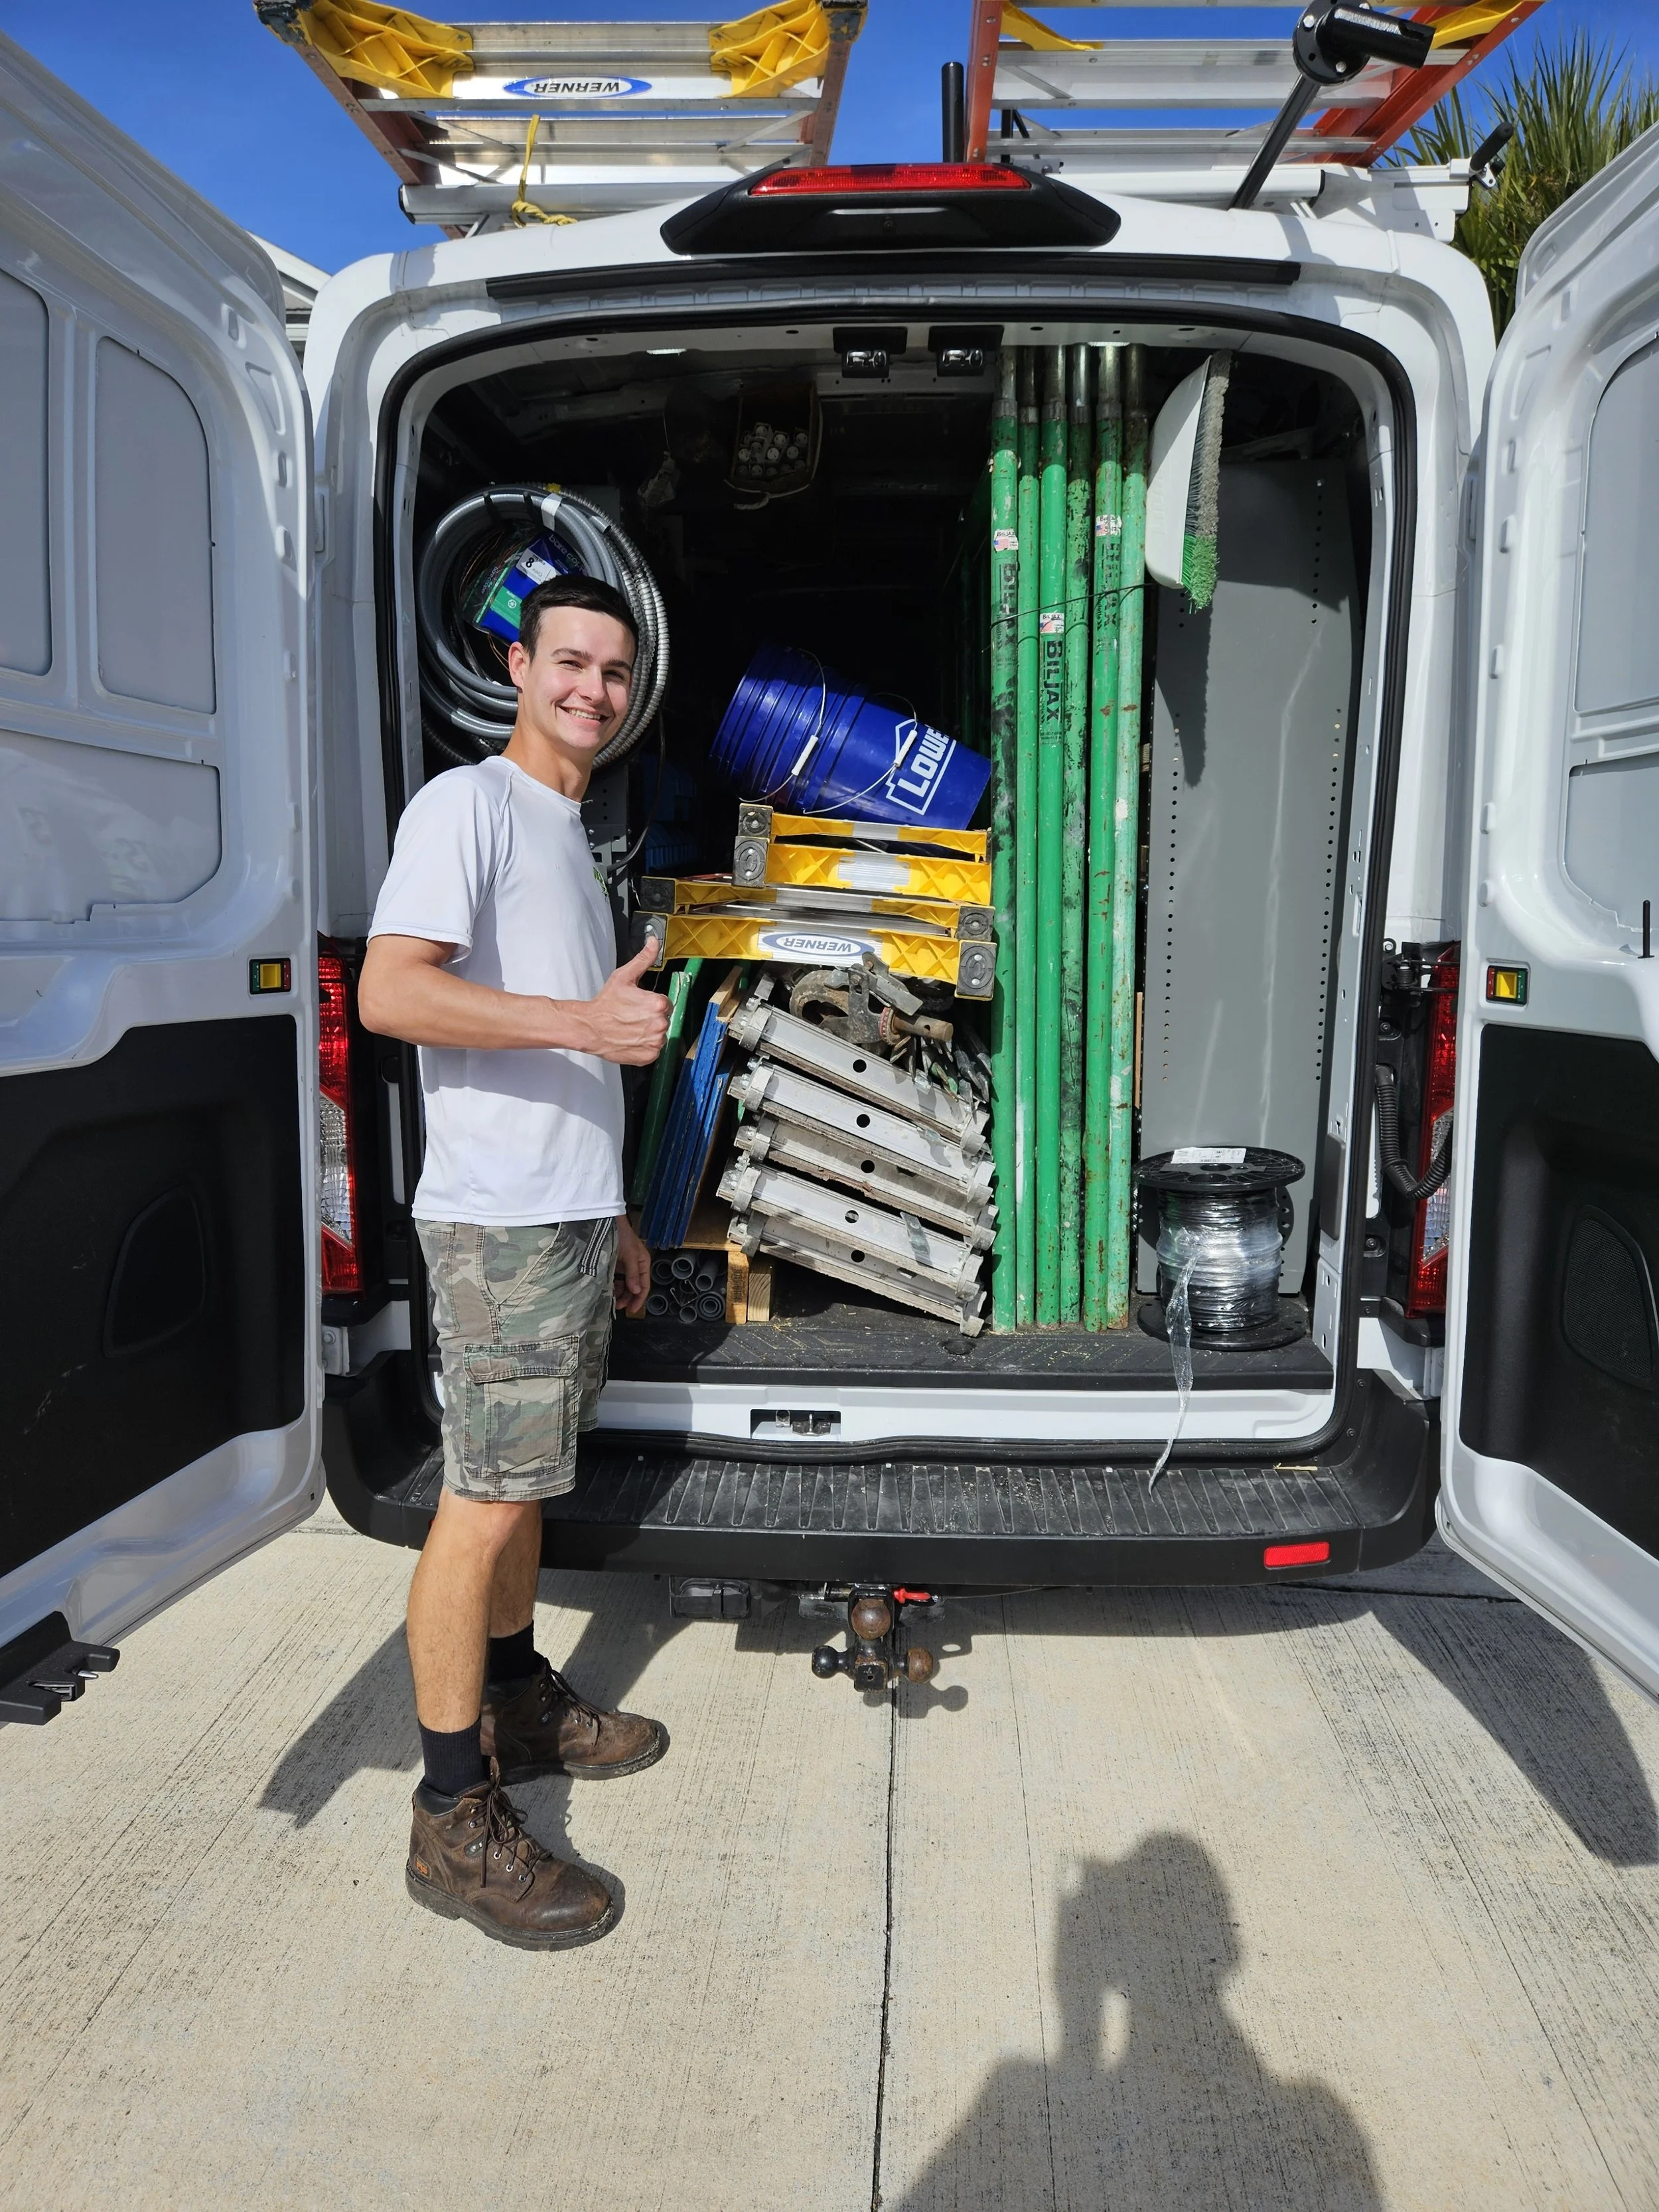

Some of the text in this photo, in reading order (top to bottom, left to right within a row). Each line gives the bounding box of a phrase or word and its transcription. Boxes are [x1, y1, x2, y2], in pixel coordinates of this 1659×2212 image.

[534, 82, 620, 94] WERNER
[549, 534, 566, 555] bare
[526, 557, 535, 568] 8
[1044, 640, 1062, 721] BILJAX
[897, 726, 950, 798] LOWE
[783, 937, 851, 953] WERNER
